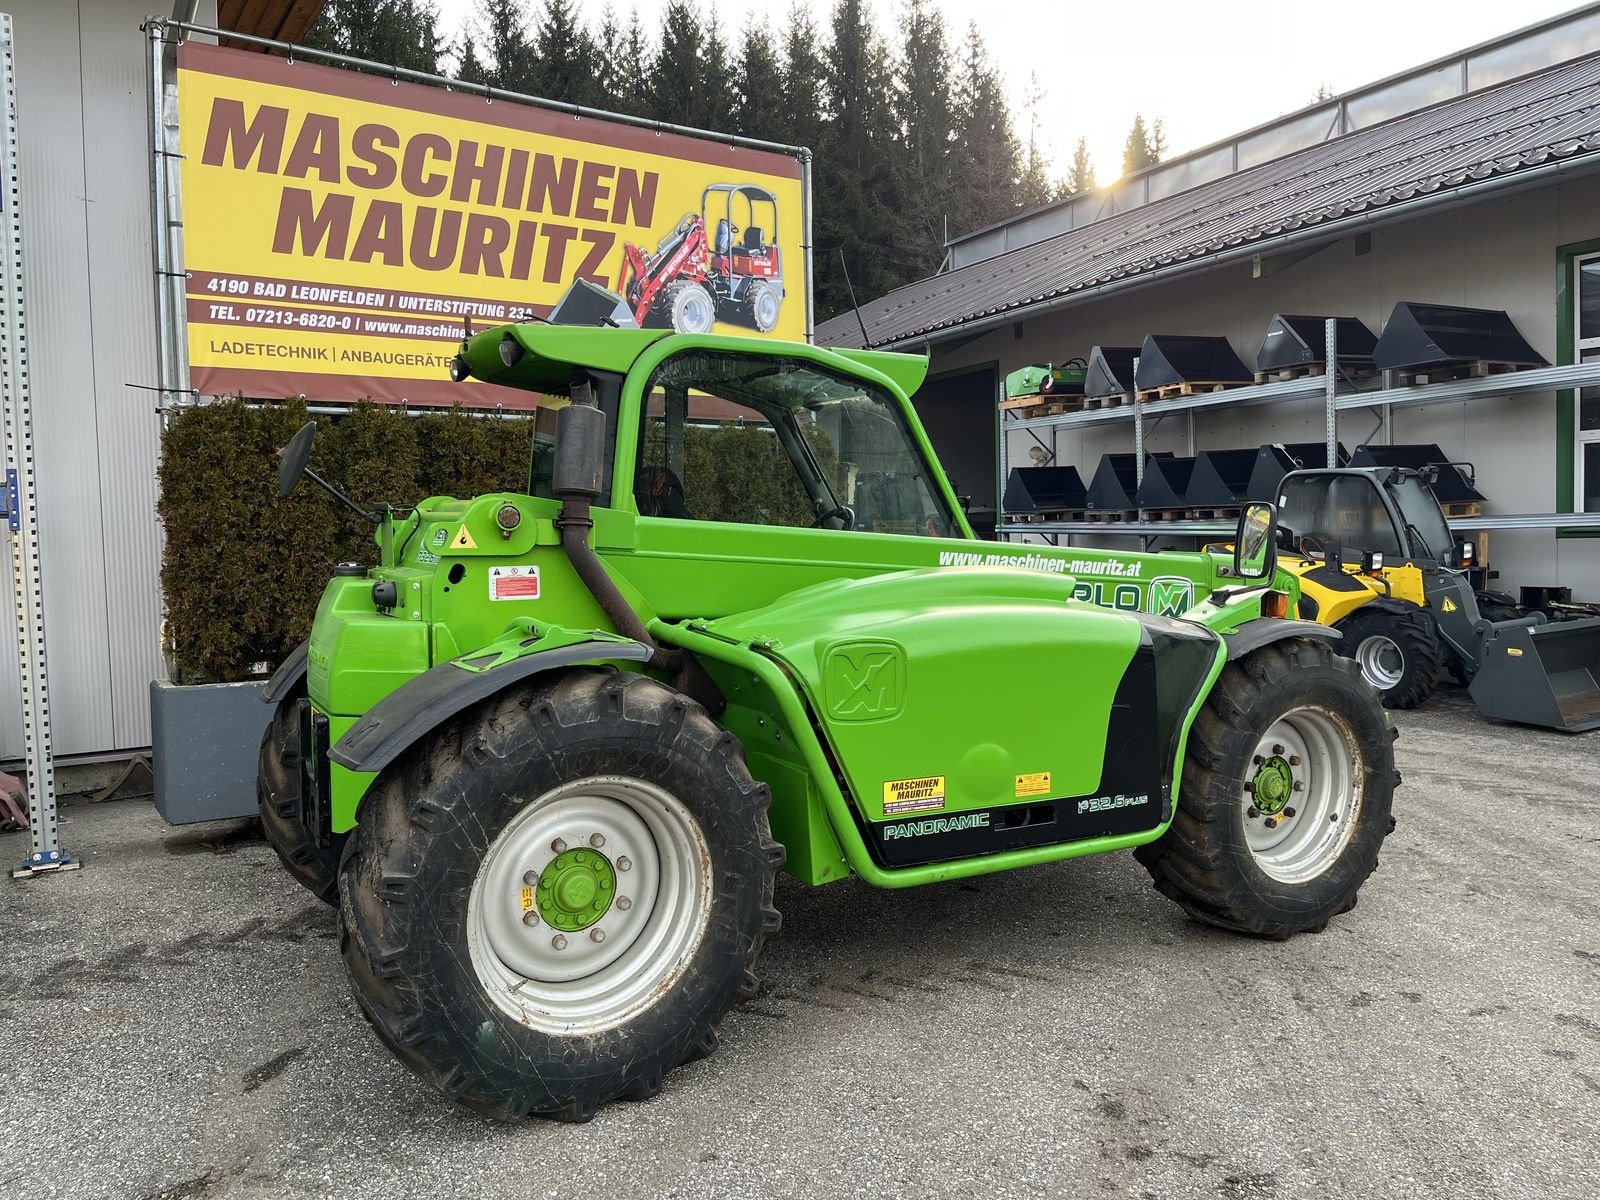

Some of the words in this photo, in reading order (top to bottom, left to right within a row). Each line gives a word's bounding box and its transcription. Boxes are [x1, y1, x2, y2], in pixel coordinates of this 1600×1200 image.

[201, 97, 659, 229] MASCHINEN
[272, 186, 616, 289] MAURITZ
[207, 278, 249, 294] 4190
[253, 282, 287, 297] BAD
[291, 286, 385, 307] LEONFELDEN
[399, 296, 505, 318] UNTERSTIFTUNG
[209, 305, 241, 320] TEL.
[246, 308, 351, 330] 07213-6820-0
[210, 340, 328, 360] LADETECHNIK
[341, 349, 452, 368] ANBAUGERÄTE
[939, 551, 1142, 576] www.maschinen-mauritz.at
[890, 779, 940, 792] MASCHINEN
[897, 788, 934, 800] MAURITZ
[883, 812, 990, 840] PANORAMIC
